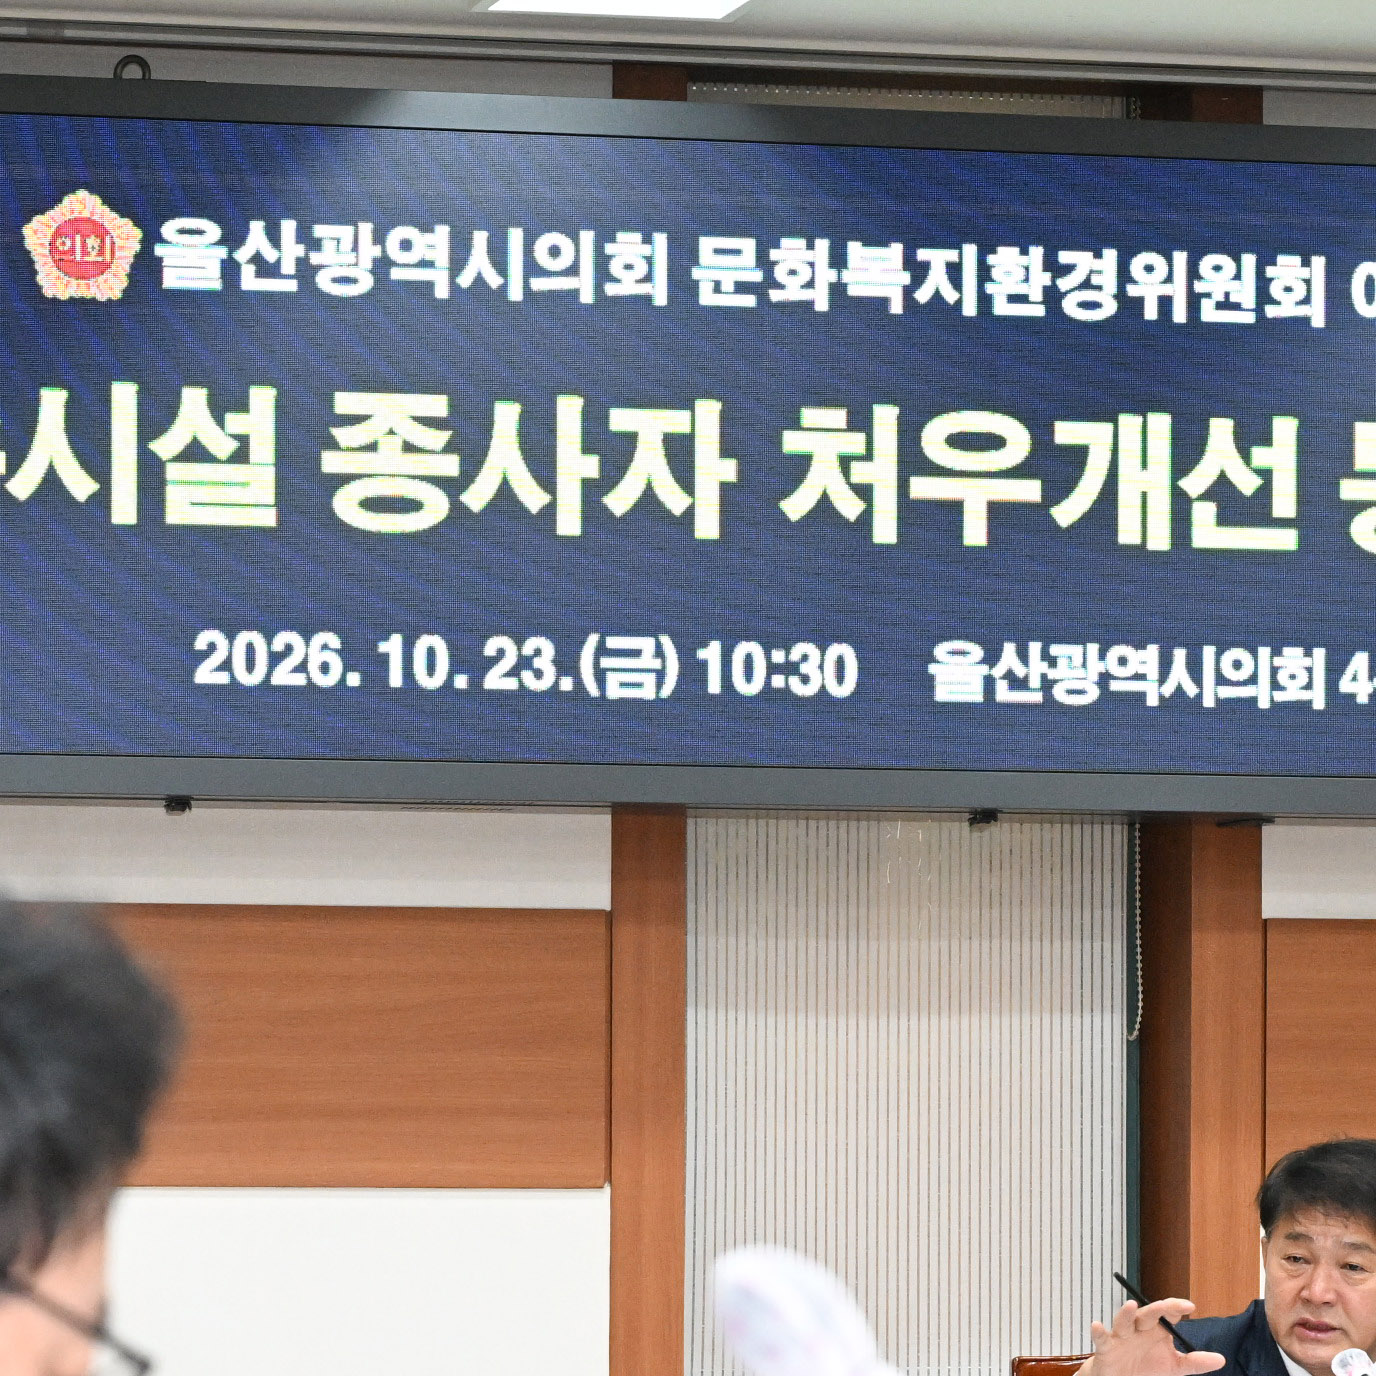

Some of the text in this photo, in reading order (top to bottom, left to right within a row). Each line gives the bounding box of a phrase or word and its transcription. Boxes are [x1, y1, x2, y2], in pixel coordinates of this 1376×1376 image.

[153, 216, 669, 308] 울산광역시의회
[690, 235, 1327, 328] 문화복지환경위원회
[320, 390, 738, 541] 종사자
[779, 404, 1300, 552] 처우개선
[192, 628, 362, 689] 2026.
[377, 632, 468, 690] 10.
[695, 639, 859, 698] 10:30
[926, 639, 1327, 711] 울산광역시의회
